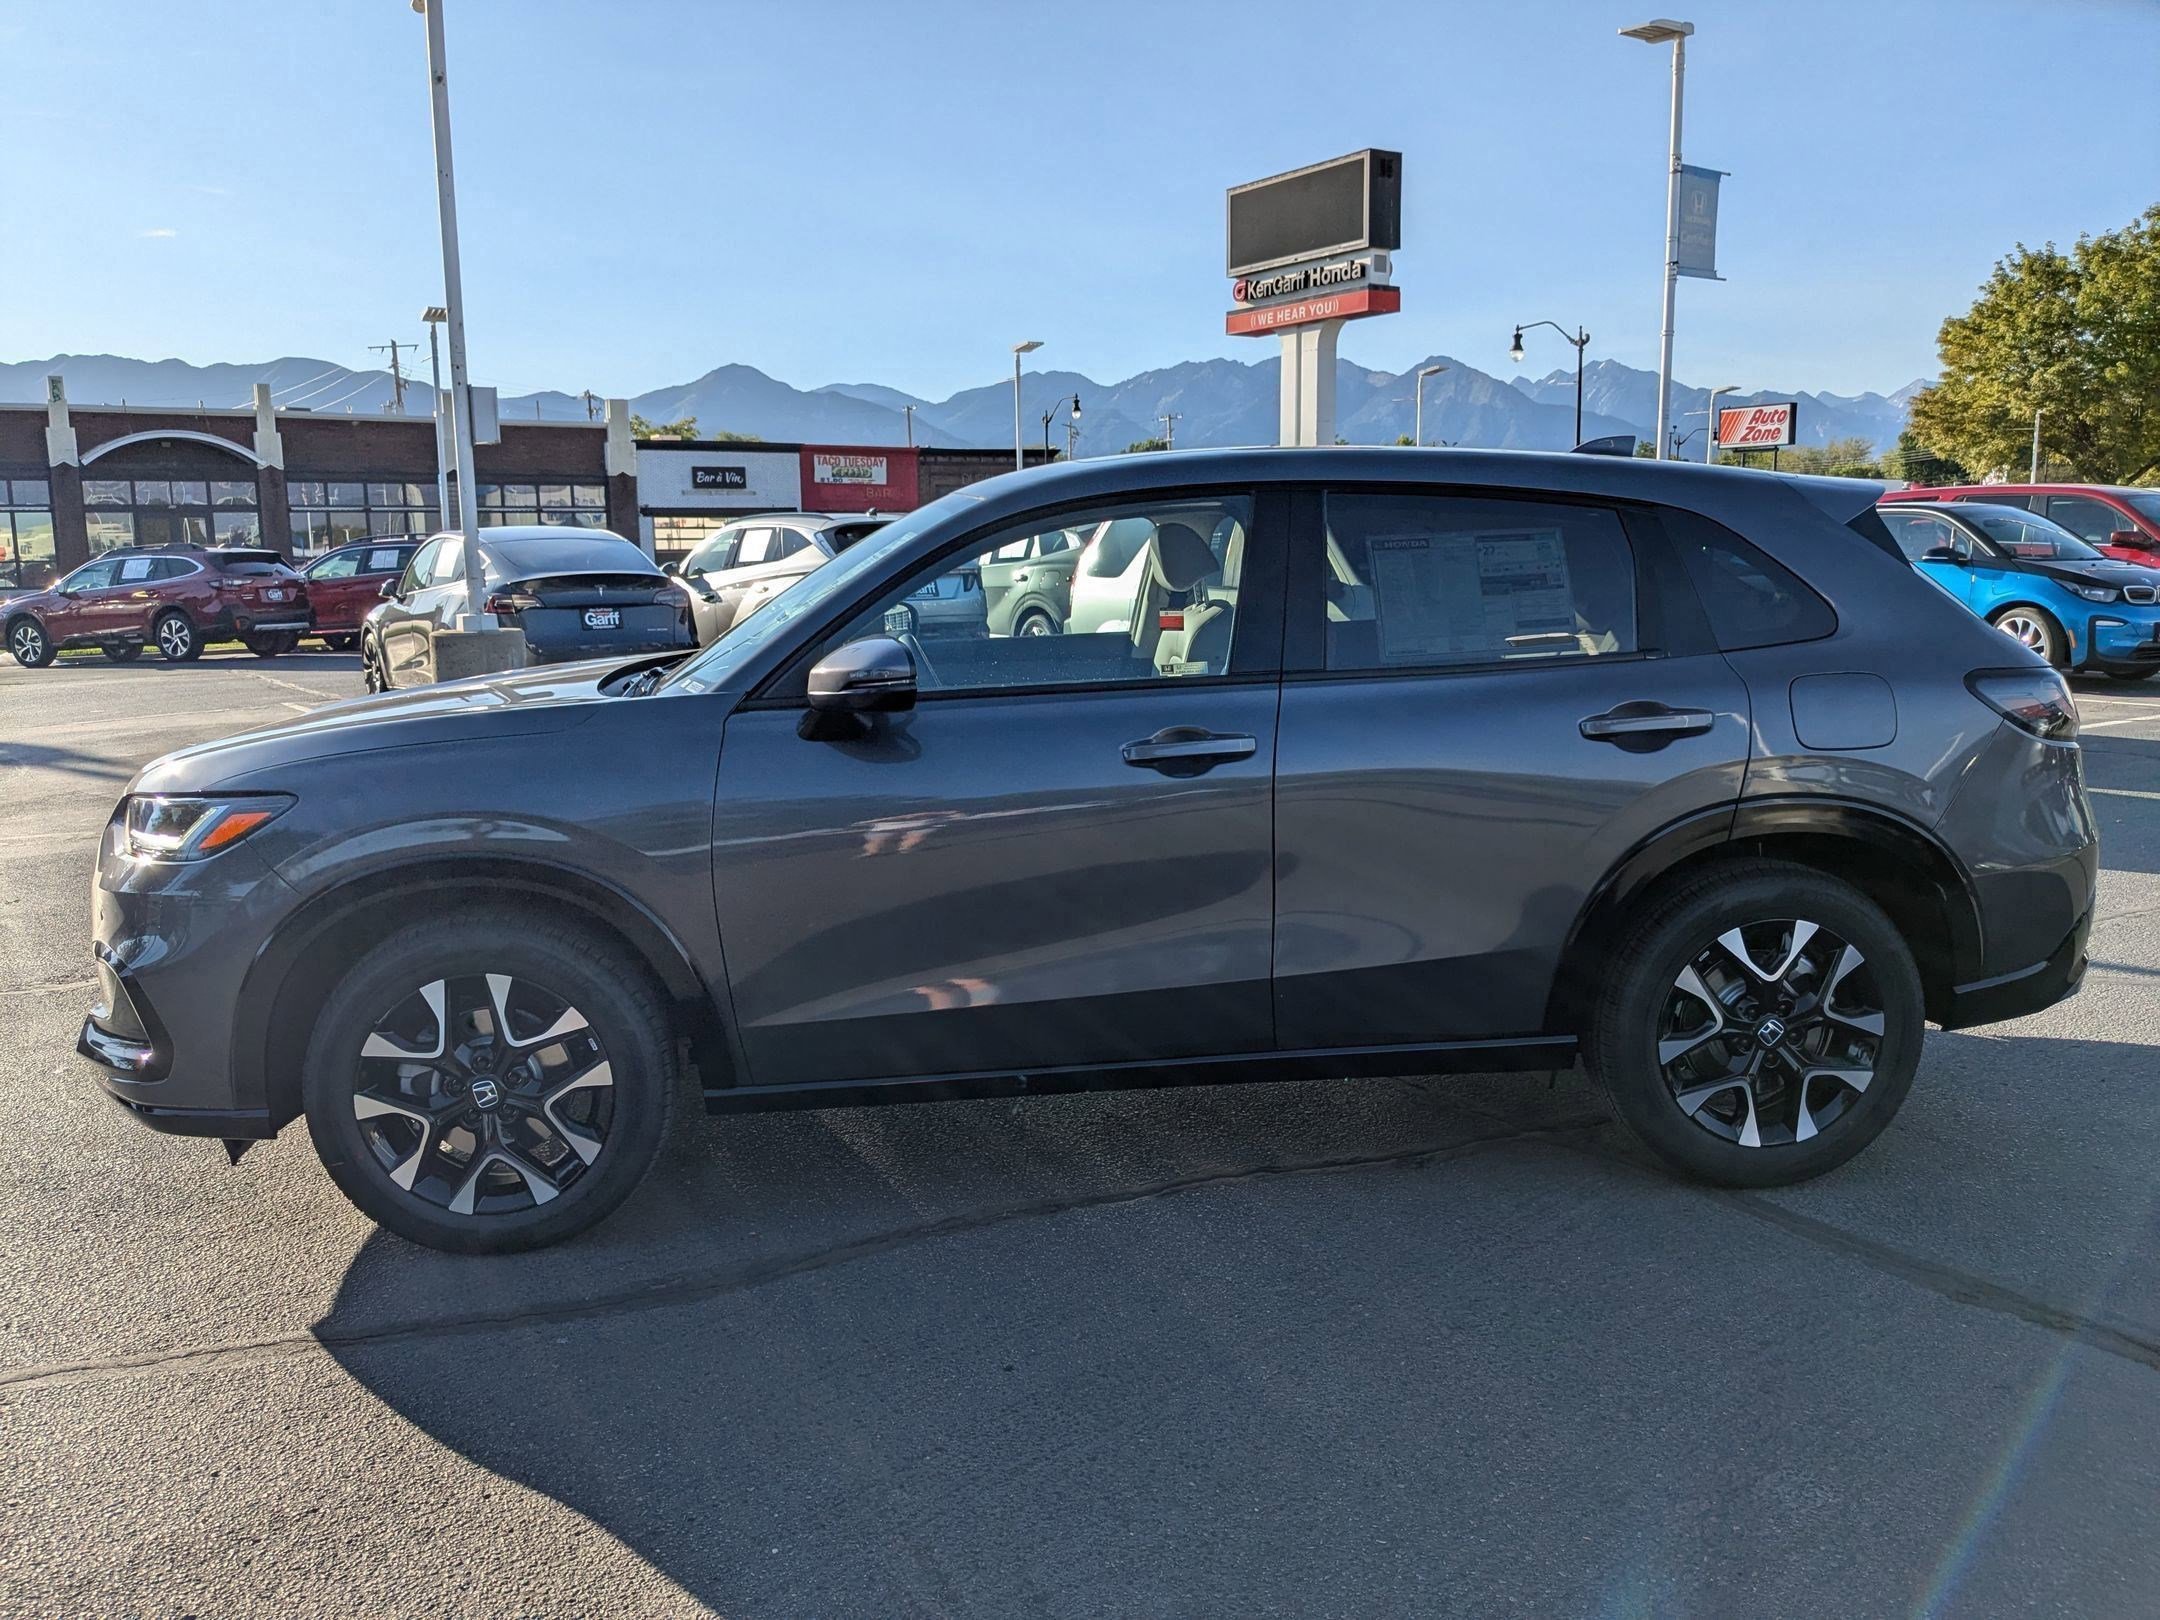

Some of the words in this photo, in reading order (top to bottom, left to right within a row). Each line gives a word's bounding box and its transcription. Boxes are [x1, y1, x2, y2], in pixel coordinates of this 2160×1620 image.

[1308, 262, 1361, 288] Honda
[1277, 306, 1306, 322] HEAR
[1748, 408, 1788, 425] Auto
[1739, 426, 1782, 442] Zone
[816, 455, 840, 466] TACO
[843, 456, 885, 467] TUESDAY
[696, 471, 715, 483] Bar
[725, 471, 744, 483] Vin
[1384, 539, 1428, 549] HONDA
[584, 612, 620, 626] Garff
